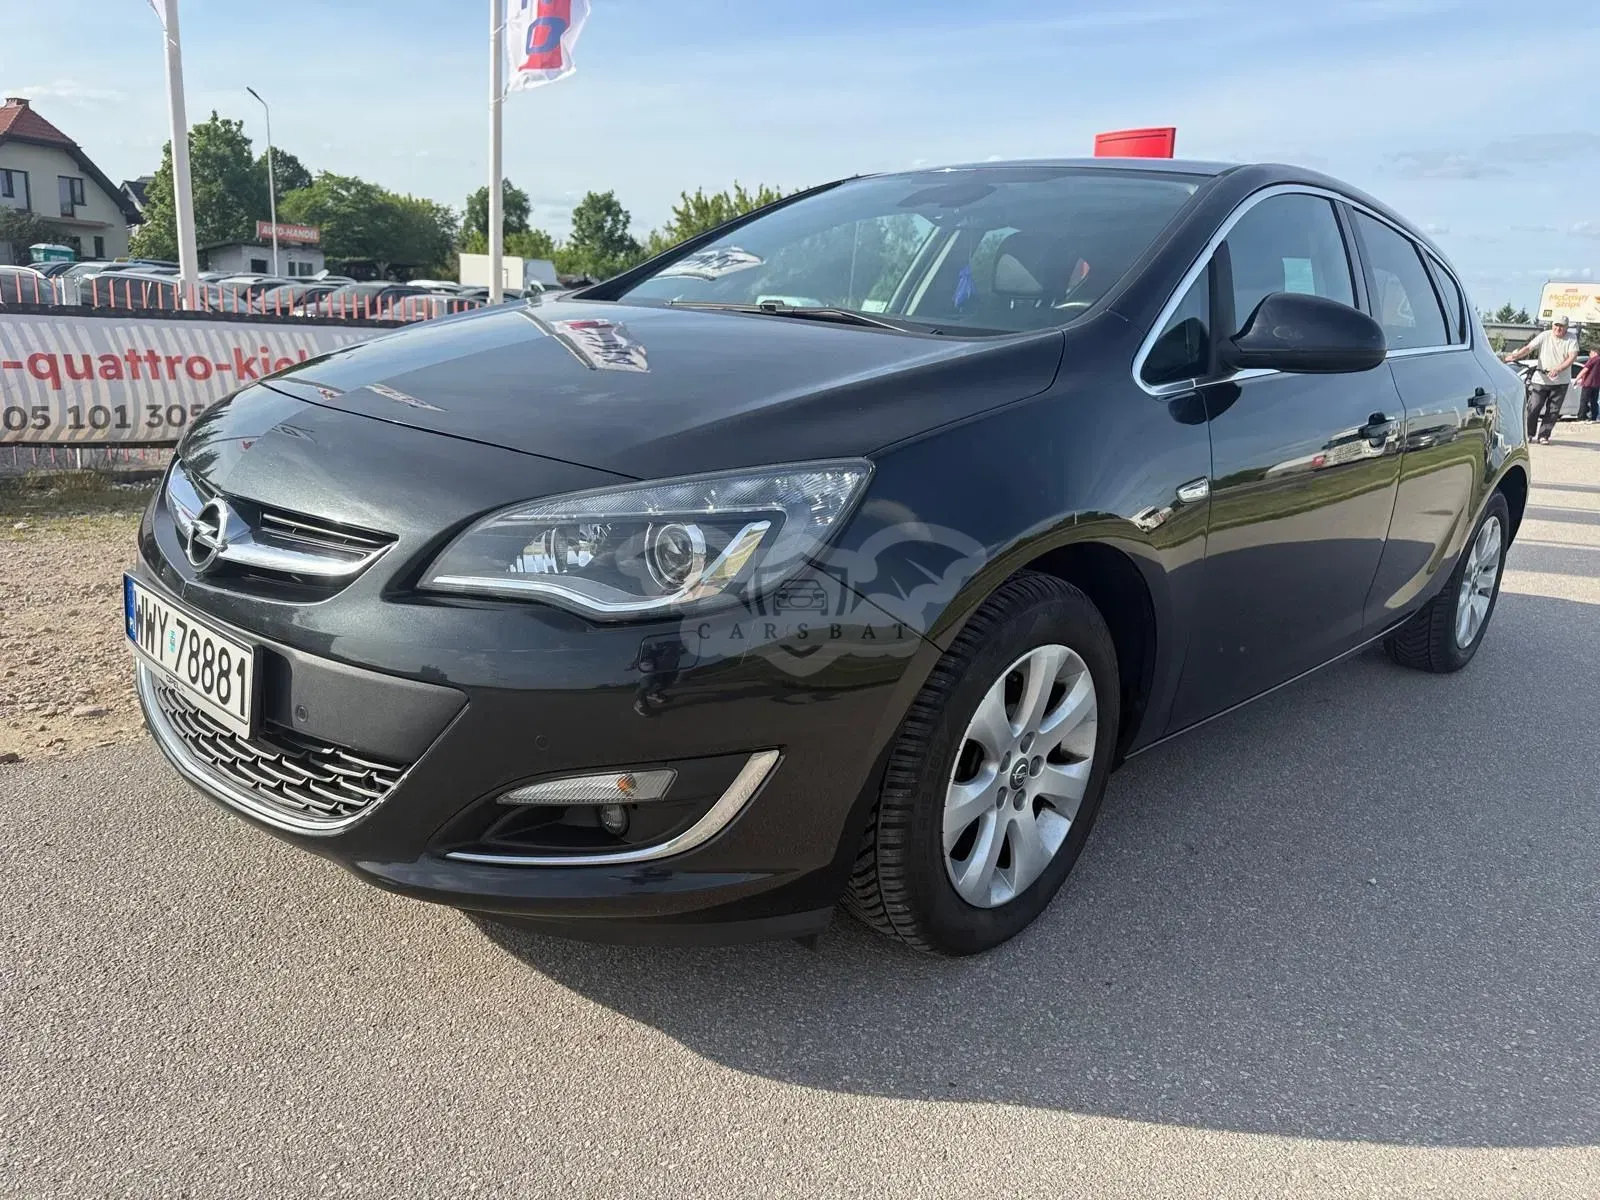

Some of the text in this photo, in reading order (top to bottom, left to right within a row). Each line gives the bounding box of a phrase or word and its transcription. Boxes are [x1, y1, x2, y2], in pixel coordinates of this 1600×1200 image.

[67, 404, 131, 429] 101
[134, 590, 246, 717] WWY 78881
